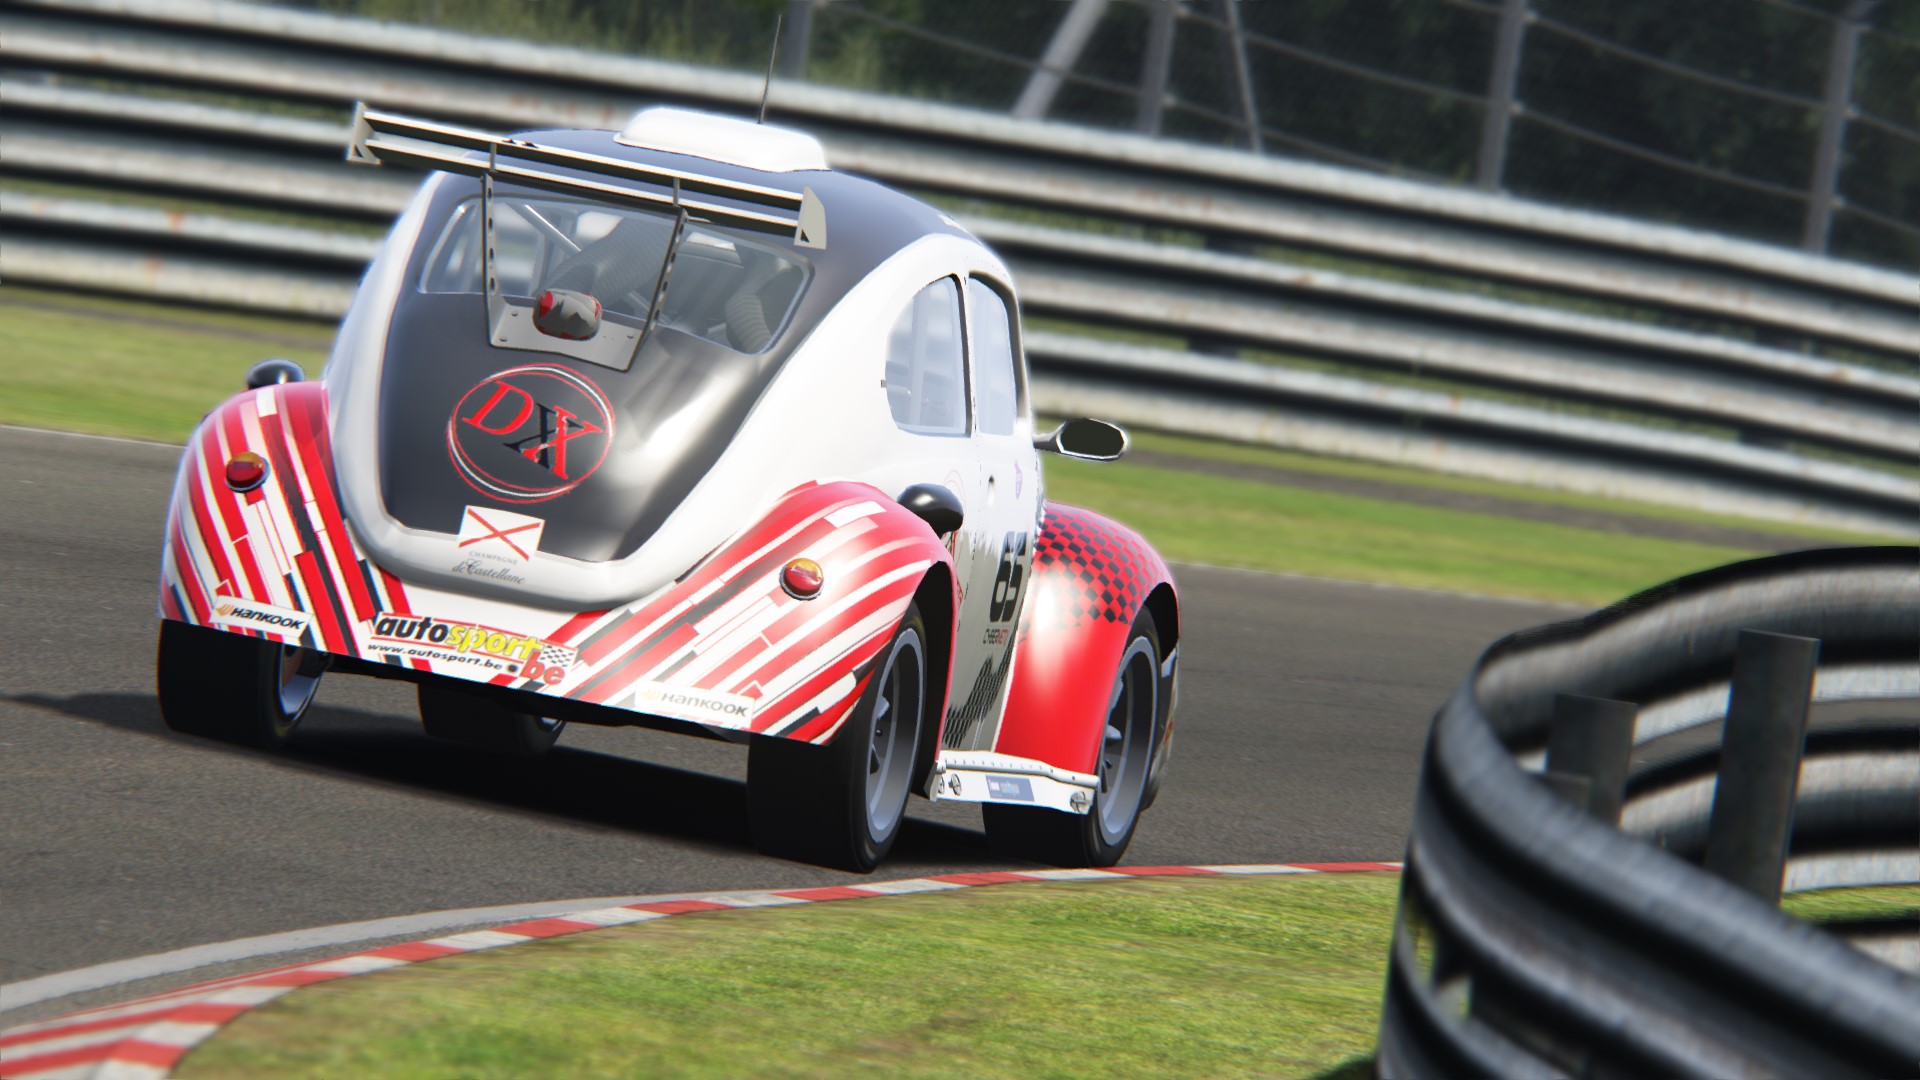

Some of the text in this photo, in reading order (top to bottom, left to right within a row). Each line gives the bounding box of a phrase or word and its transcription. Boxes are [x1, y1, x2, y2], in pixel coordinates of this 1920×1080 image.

[990, 531, 1028, 622] 65
[368, 643, 503, 671] www.autosport.be
[375, 617, 543, 660] autosport
